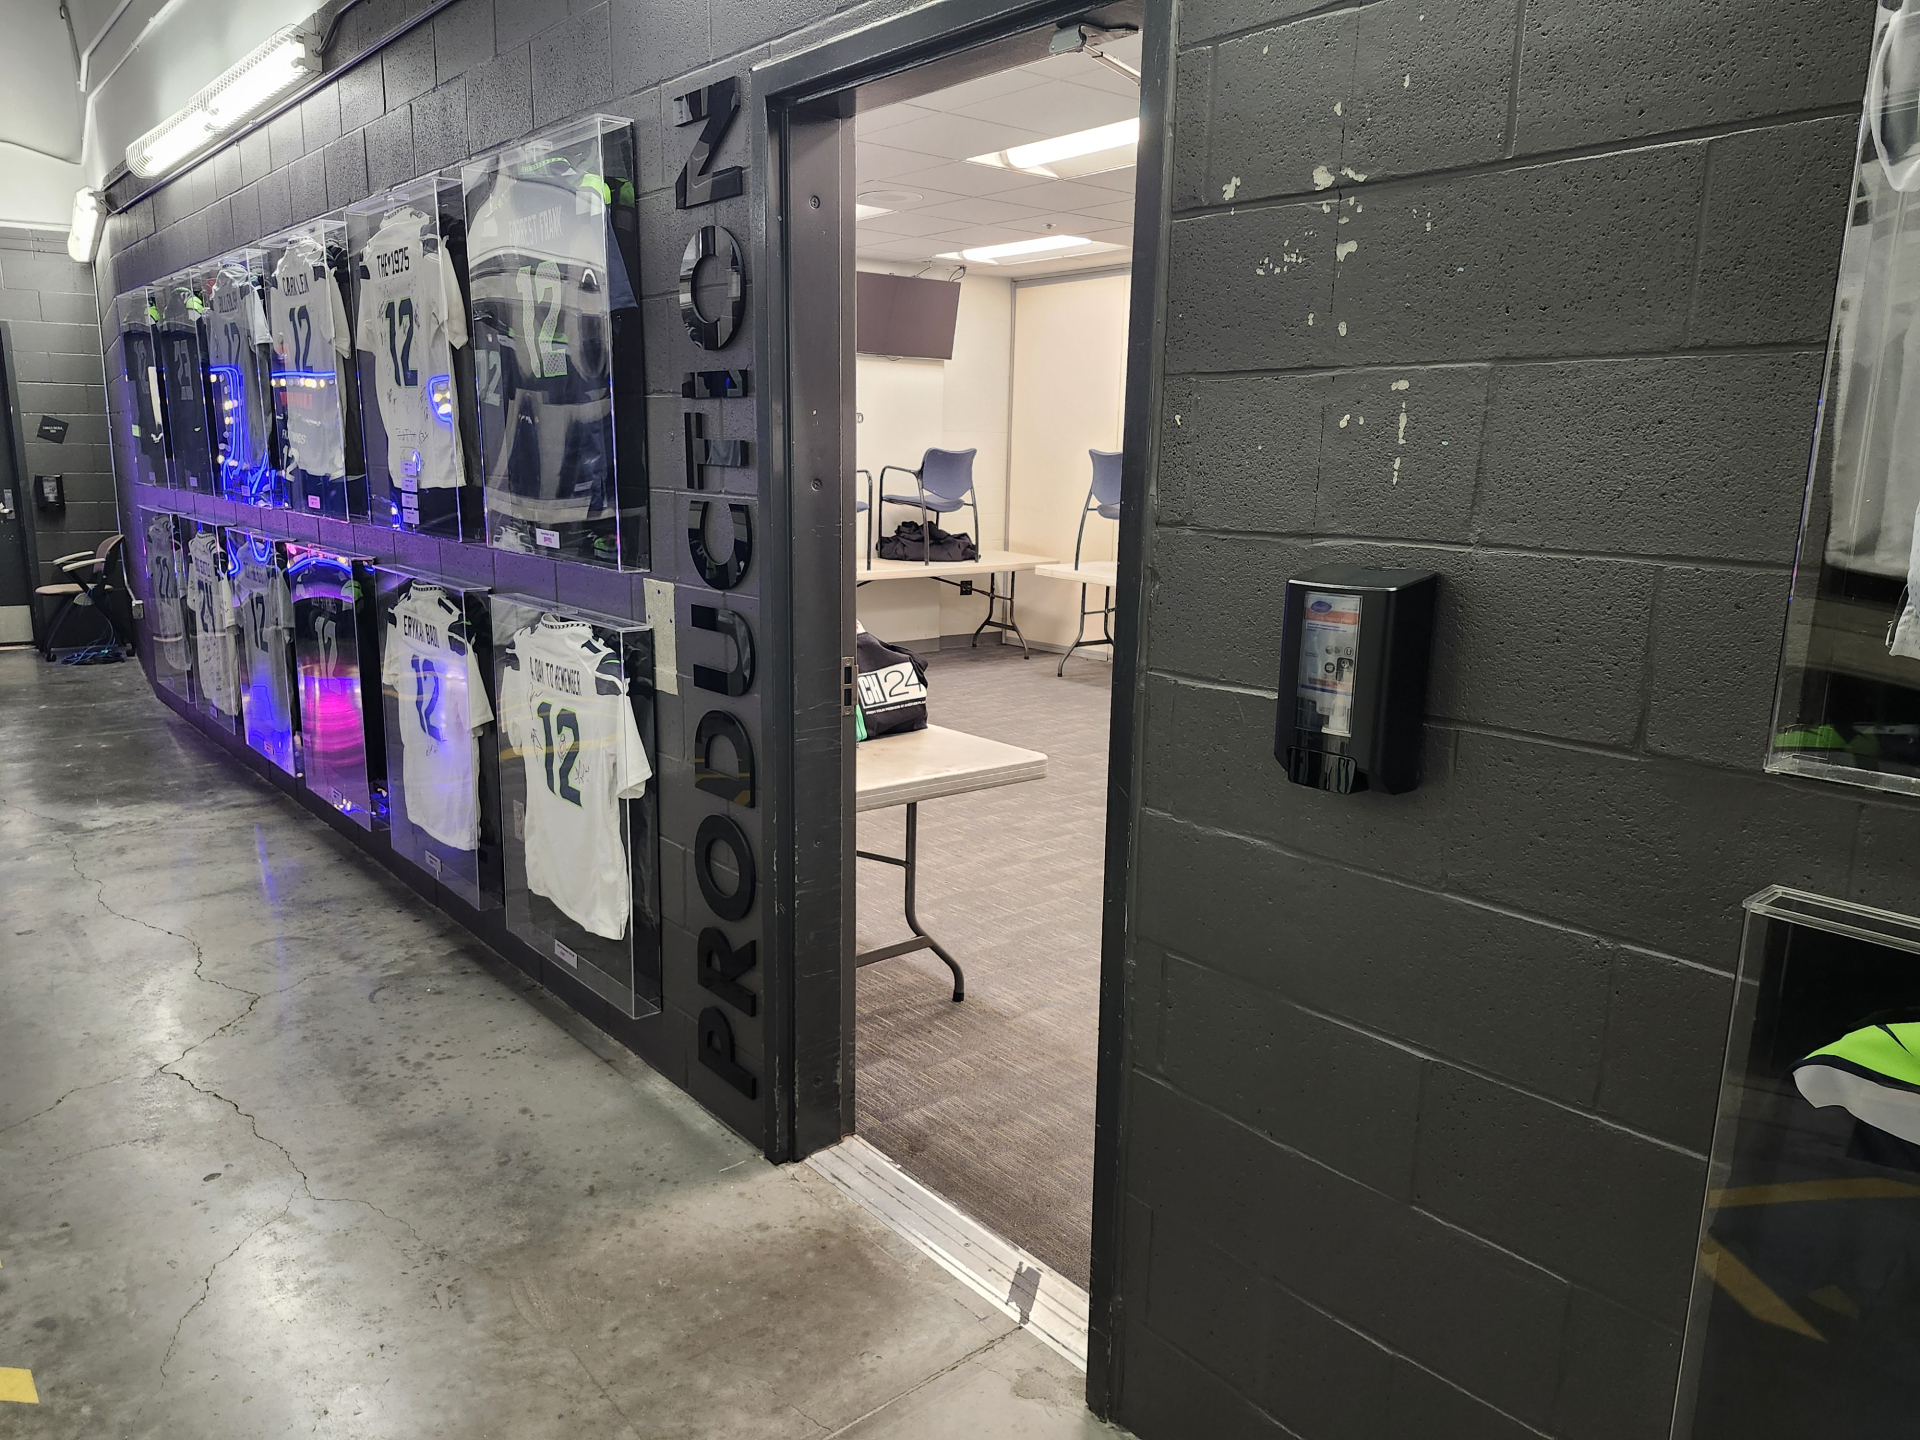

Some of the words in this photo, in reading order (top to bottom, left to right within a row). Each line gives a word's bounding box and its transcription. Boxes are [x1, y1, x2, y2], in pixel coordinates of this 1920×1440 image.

[539, 205, 563, 242] FRANK
[377, 252, 389, 278] THE
[390, 247, 410, 275] 1975
[289, 304, 314, 375] 12
[385, 296, 418, 388] 12
[516, 259, 567, 378] 12
[250, 591, 269, 653] 12
[674, 76, 757, 1101] PRODUCTION
[314, 616, 341, 695] 12
[545, 662, 554, 688] TO
[555, 664, 583, 697] REMEMBER
[885, 670, 921, 697] 24
[411, 654, 443, 742] 12
[537, 699, 583, 810] 12
